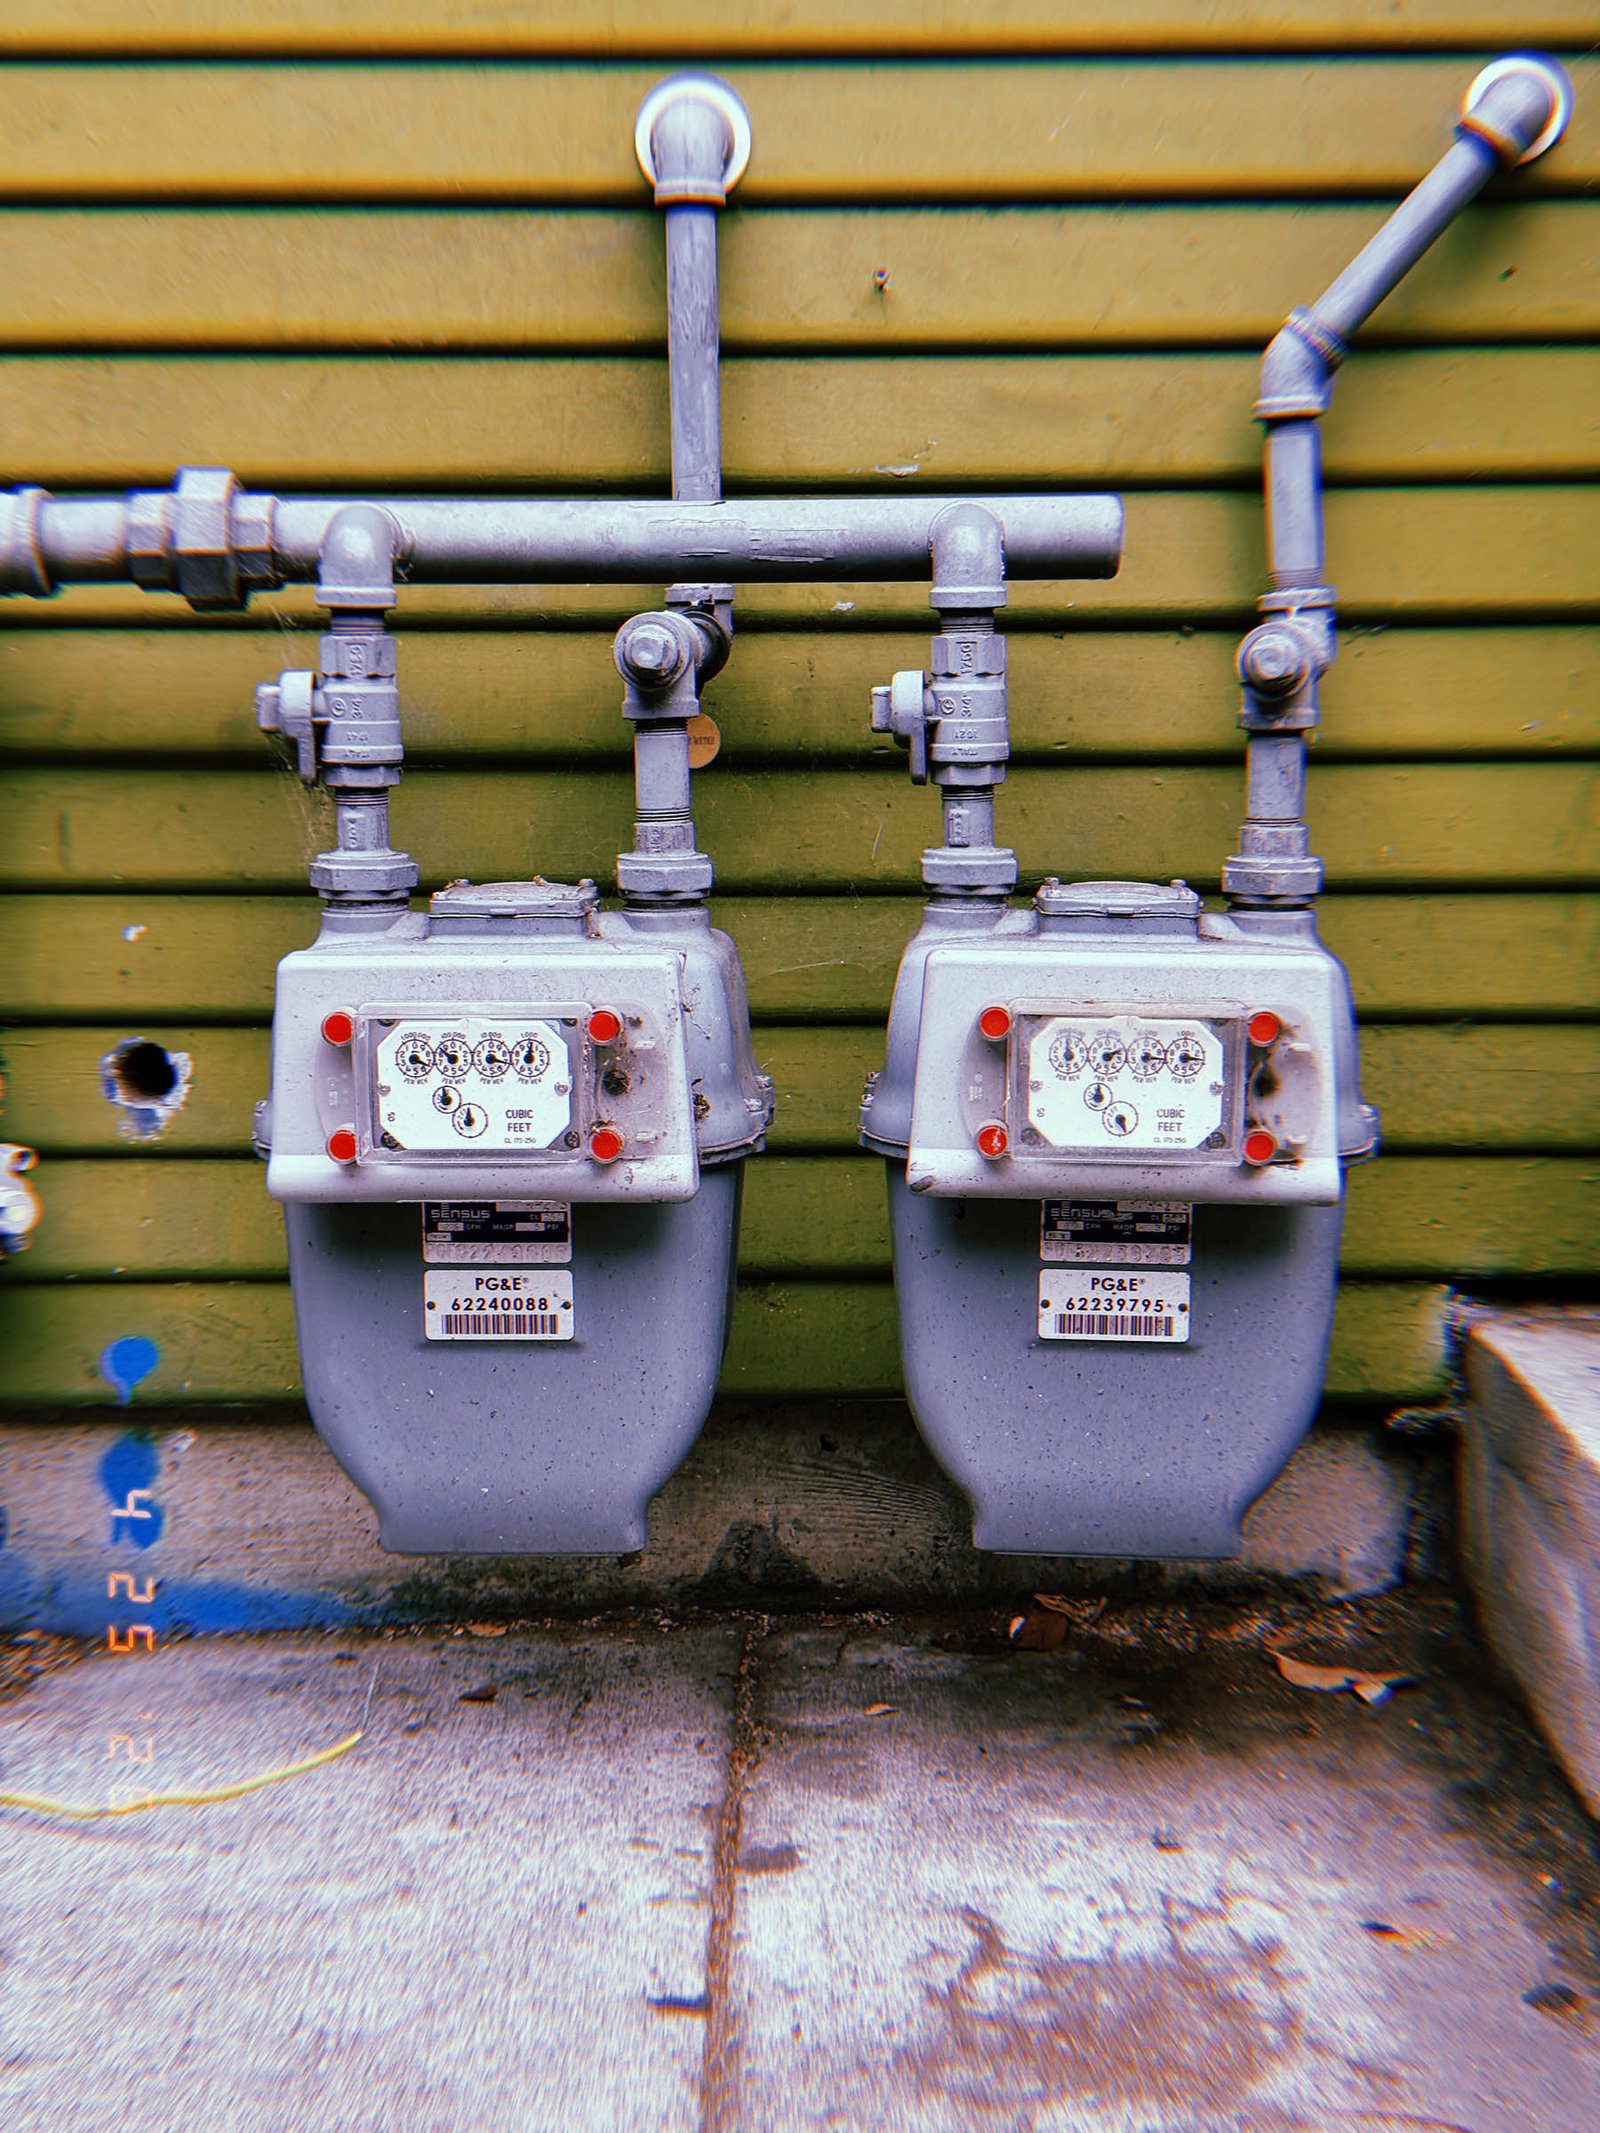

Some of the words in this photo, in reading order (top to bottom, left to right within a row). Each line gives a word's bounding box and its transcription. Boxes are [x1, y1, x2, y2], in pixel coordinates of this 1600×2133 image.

[505, 1109, 534, 1119] CUBIC
[1156, 1108, 1186, 1119] CUBIC
[507, 1122, 532, 1133] FEET
[1157, 1121, 1183, 1132] FEET
[451, 1297, 549, 1311] 62240088
[1065, 1297, 1165, 1313] 62239795
